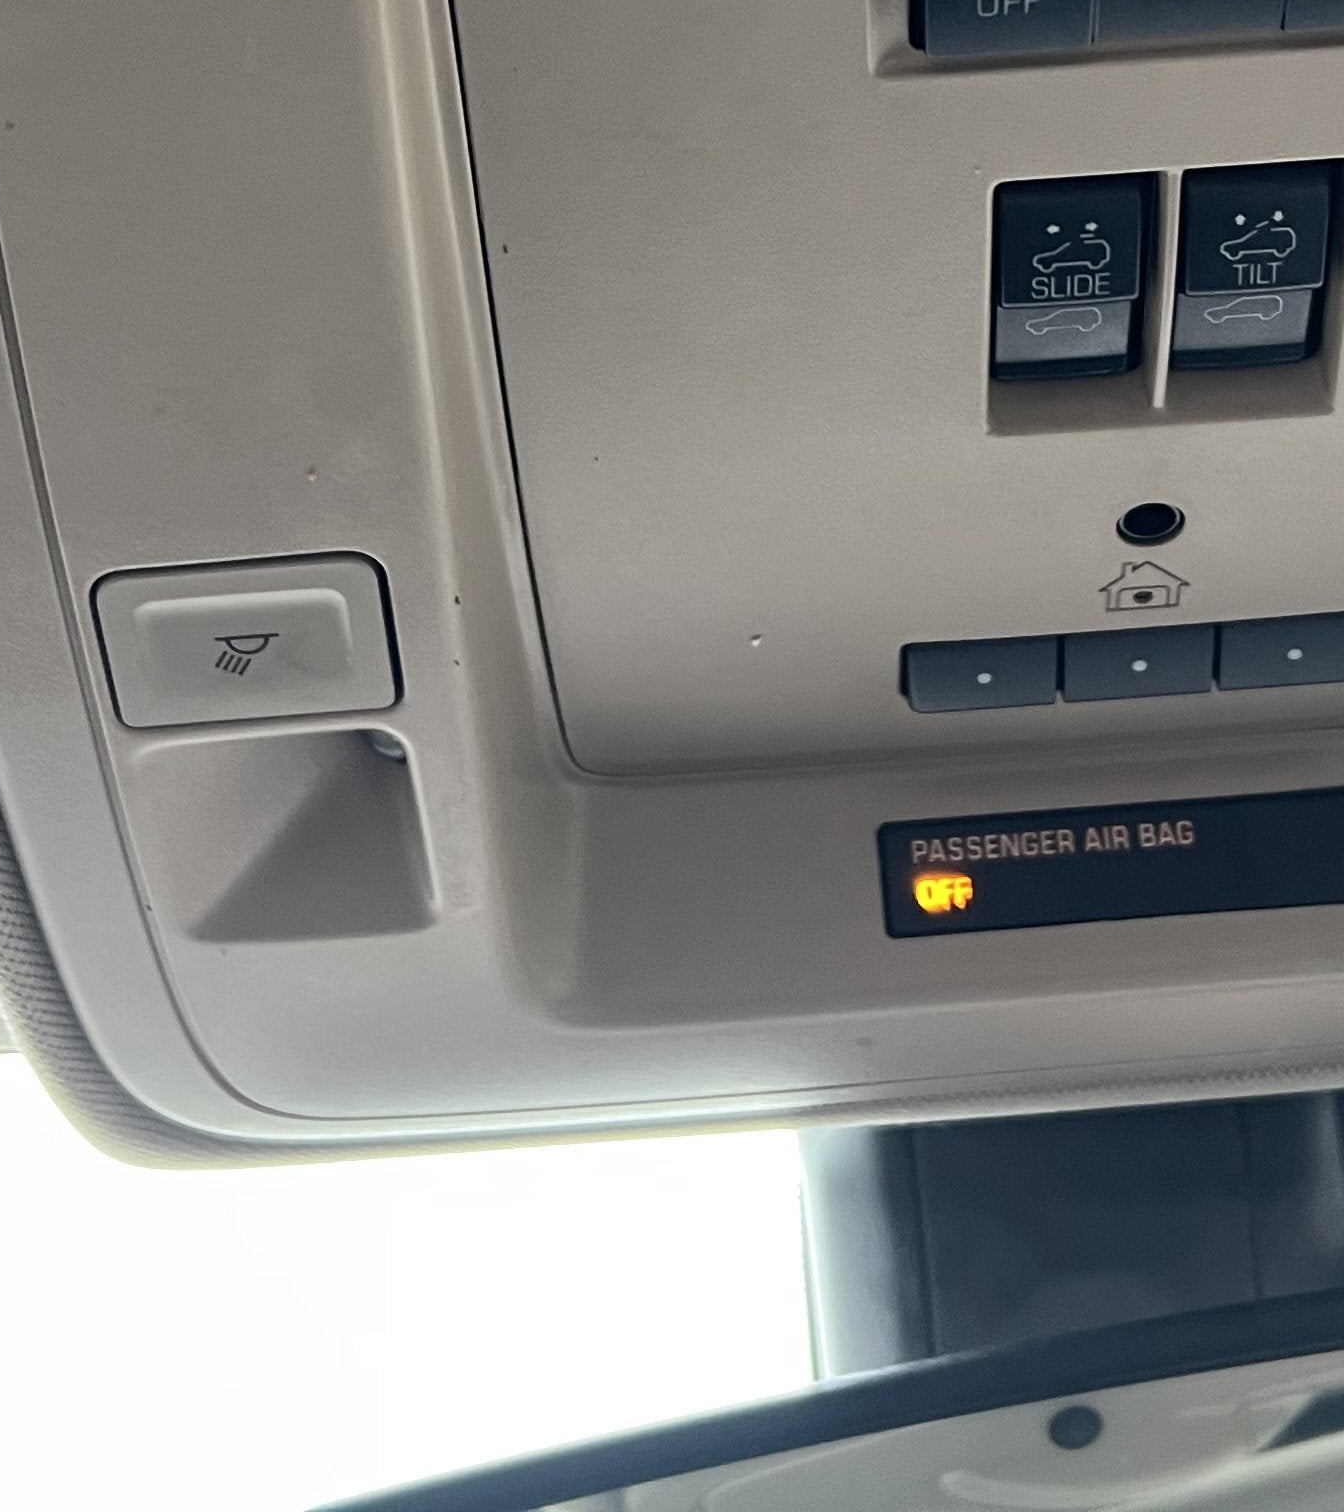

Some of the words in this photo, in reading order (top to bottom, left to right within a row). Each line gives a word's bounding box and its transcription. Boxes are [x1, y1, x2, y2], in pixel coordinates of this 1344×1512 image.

[1031, 272, 1111, 300] SLIDE
[1232, 261, 1283, 285] TILT
[911, 829, 1075, 864] PASSENGER
[1084, 825, 1131, 852] AIR
[1138, 820, 1196, 848] BAG
[913, 875, 974, 912] OFF
